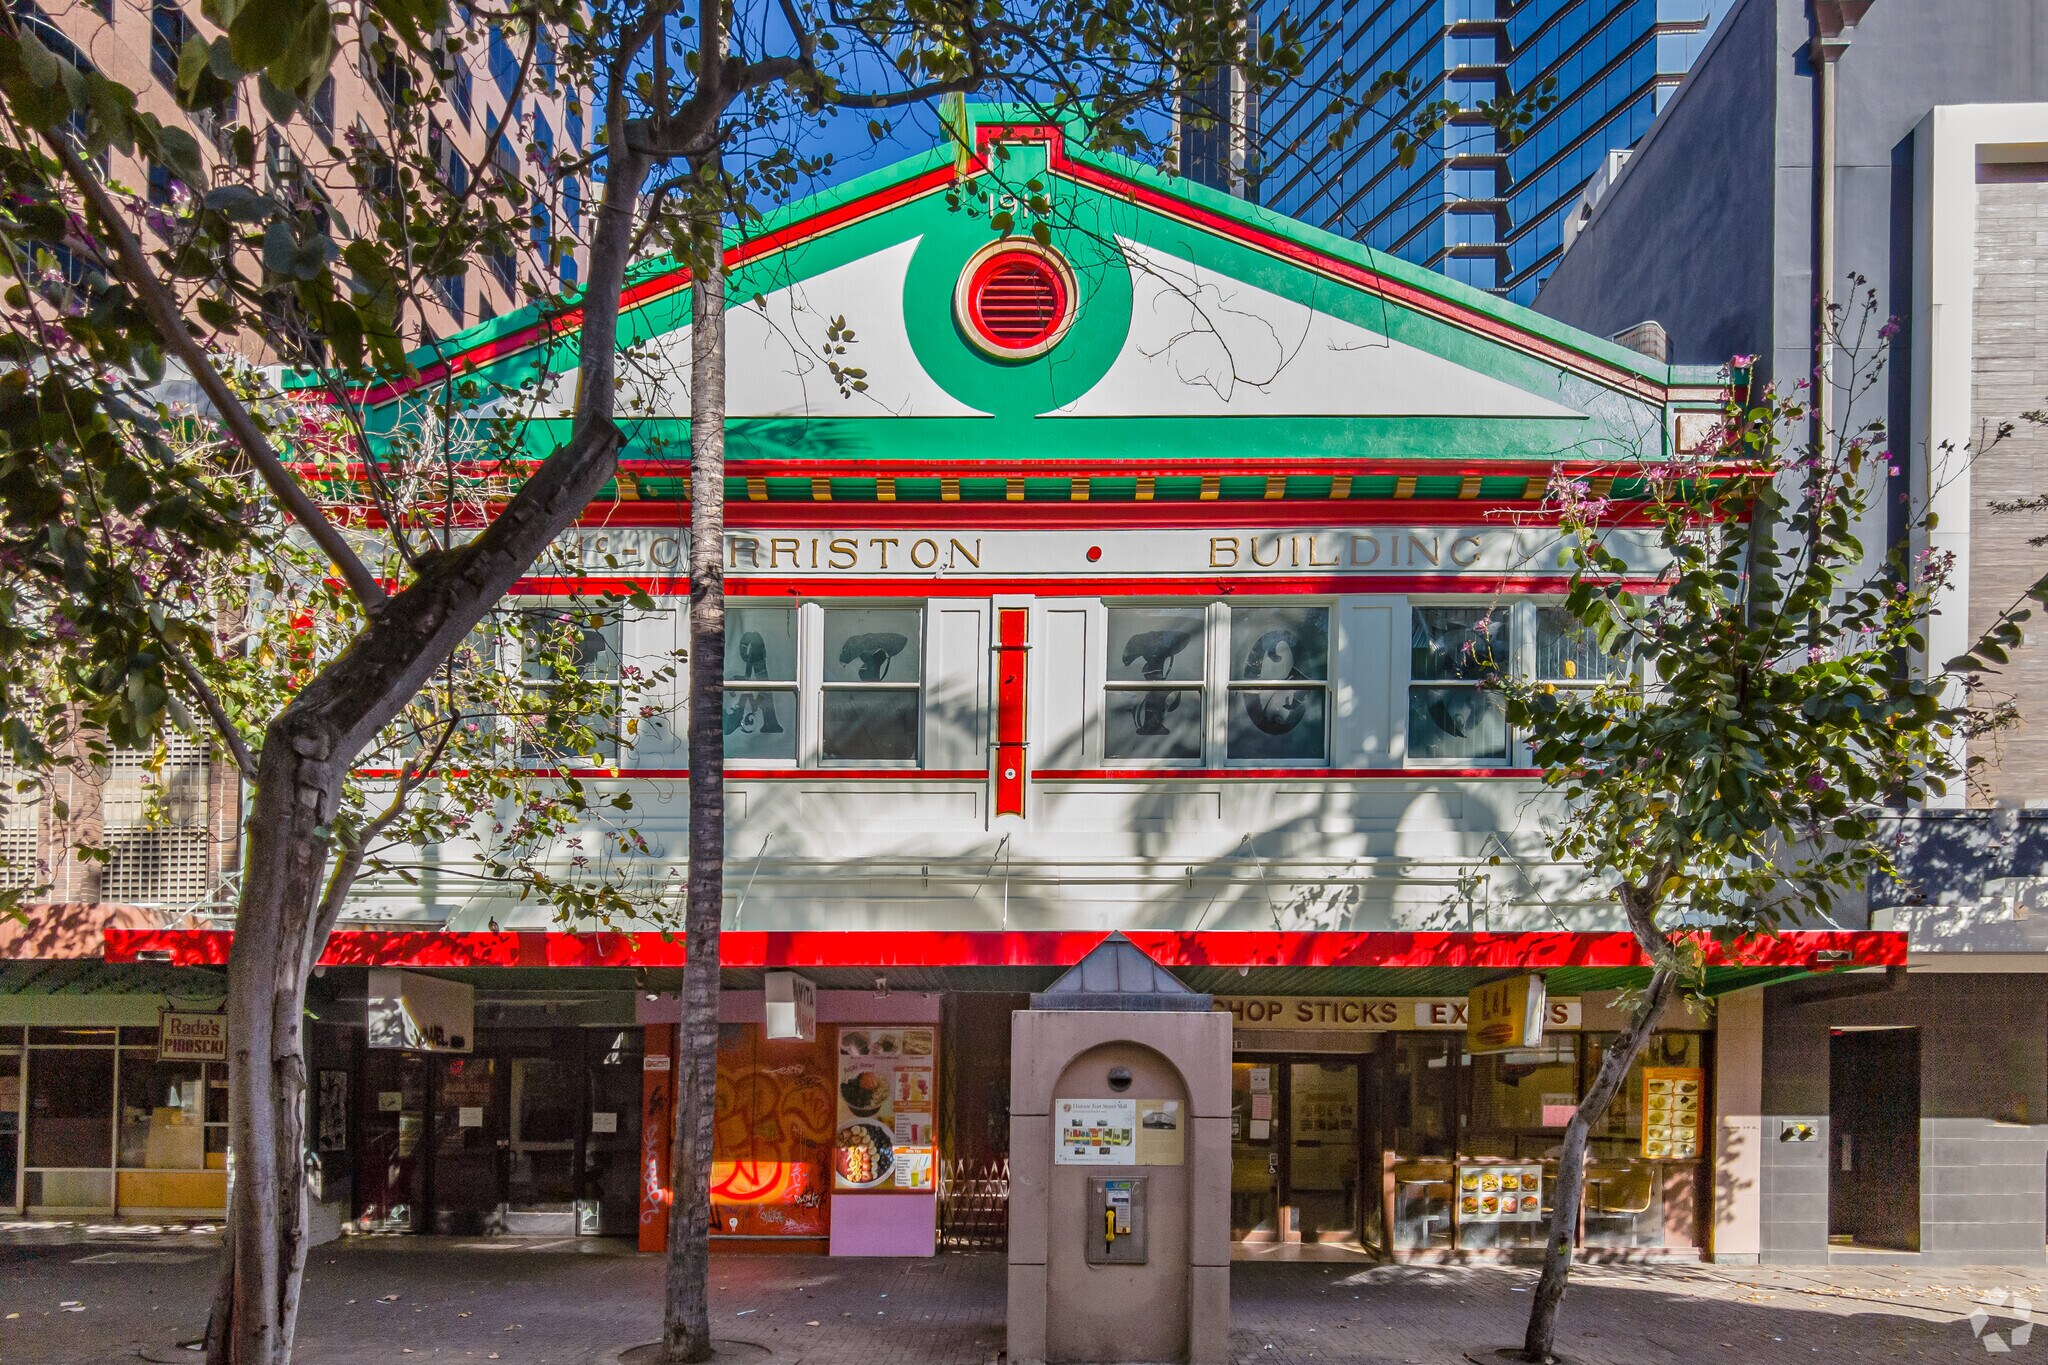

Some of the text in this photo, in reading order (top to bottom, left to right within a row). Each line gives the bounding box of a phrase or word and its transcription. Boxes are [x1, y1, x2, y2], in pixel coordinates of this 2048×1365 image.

[1209, 536, 1481, 568] BUILDING
[1297, 1002, 1397, 1023] STICKS
[171, 1018, 220, 1036] Rada's
